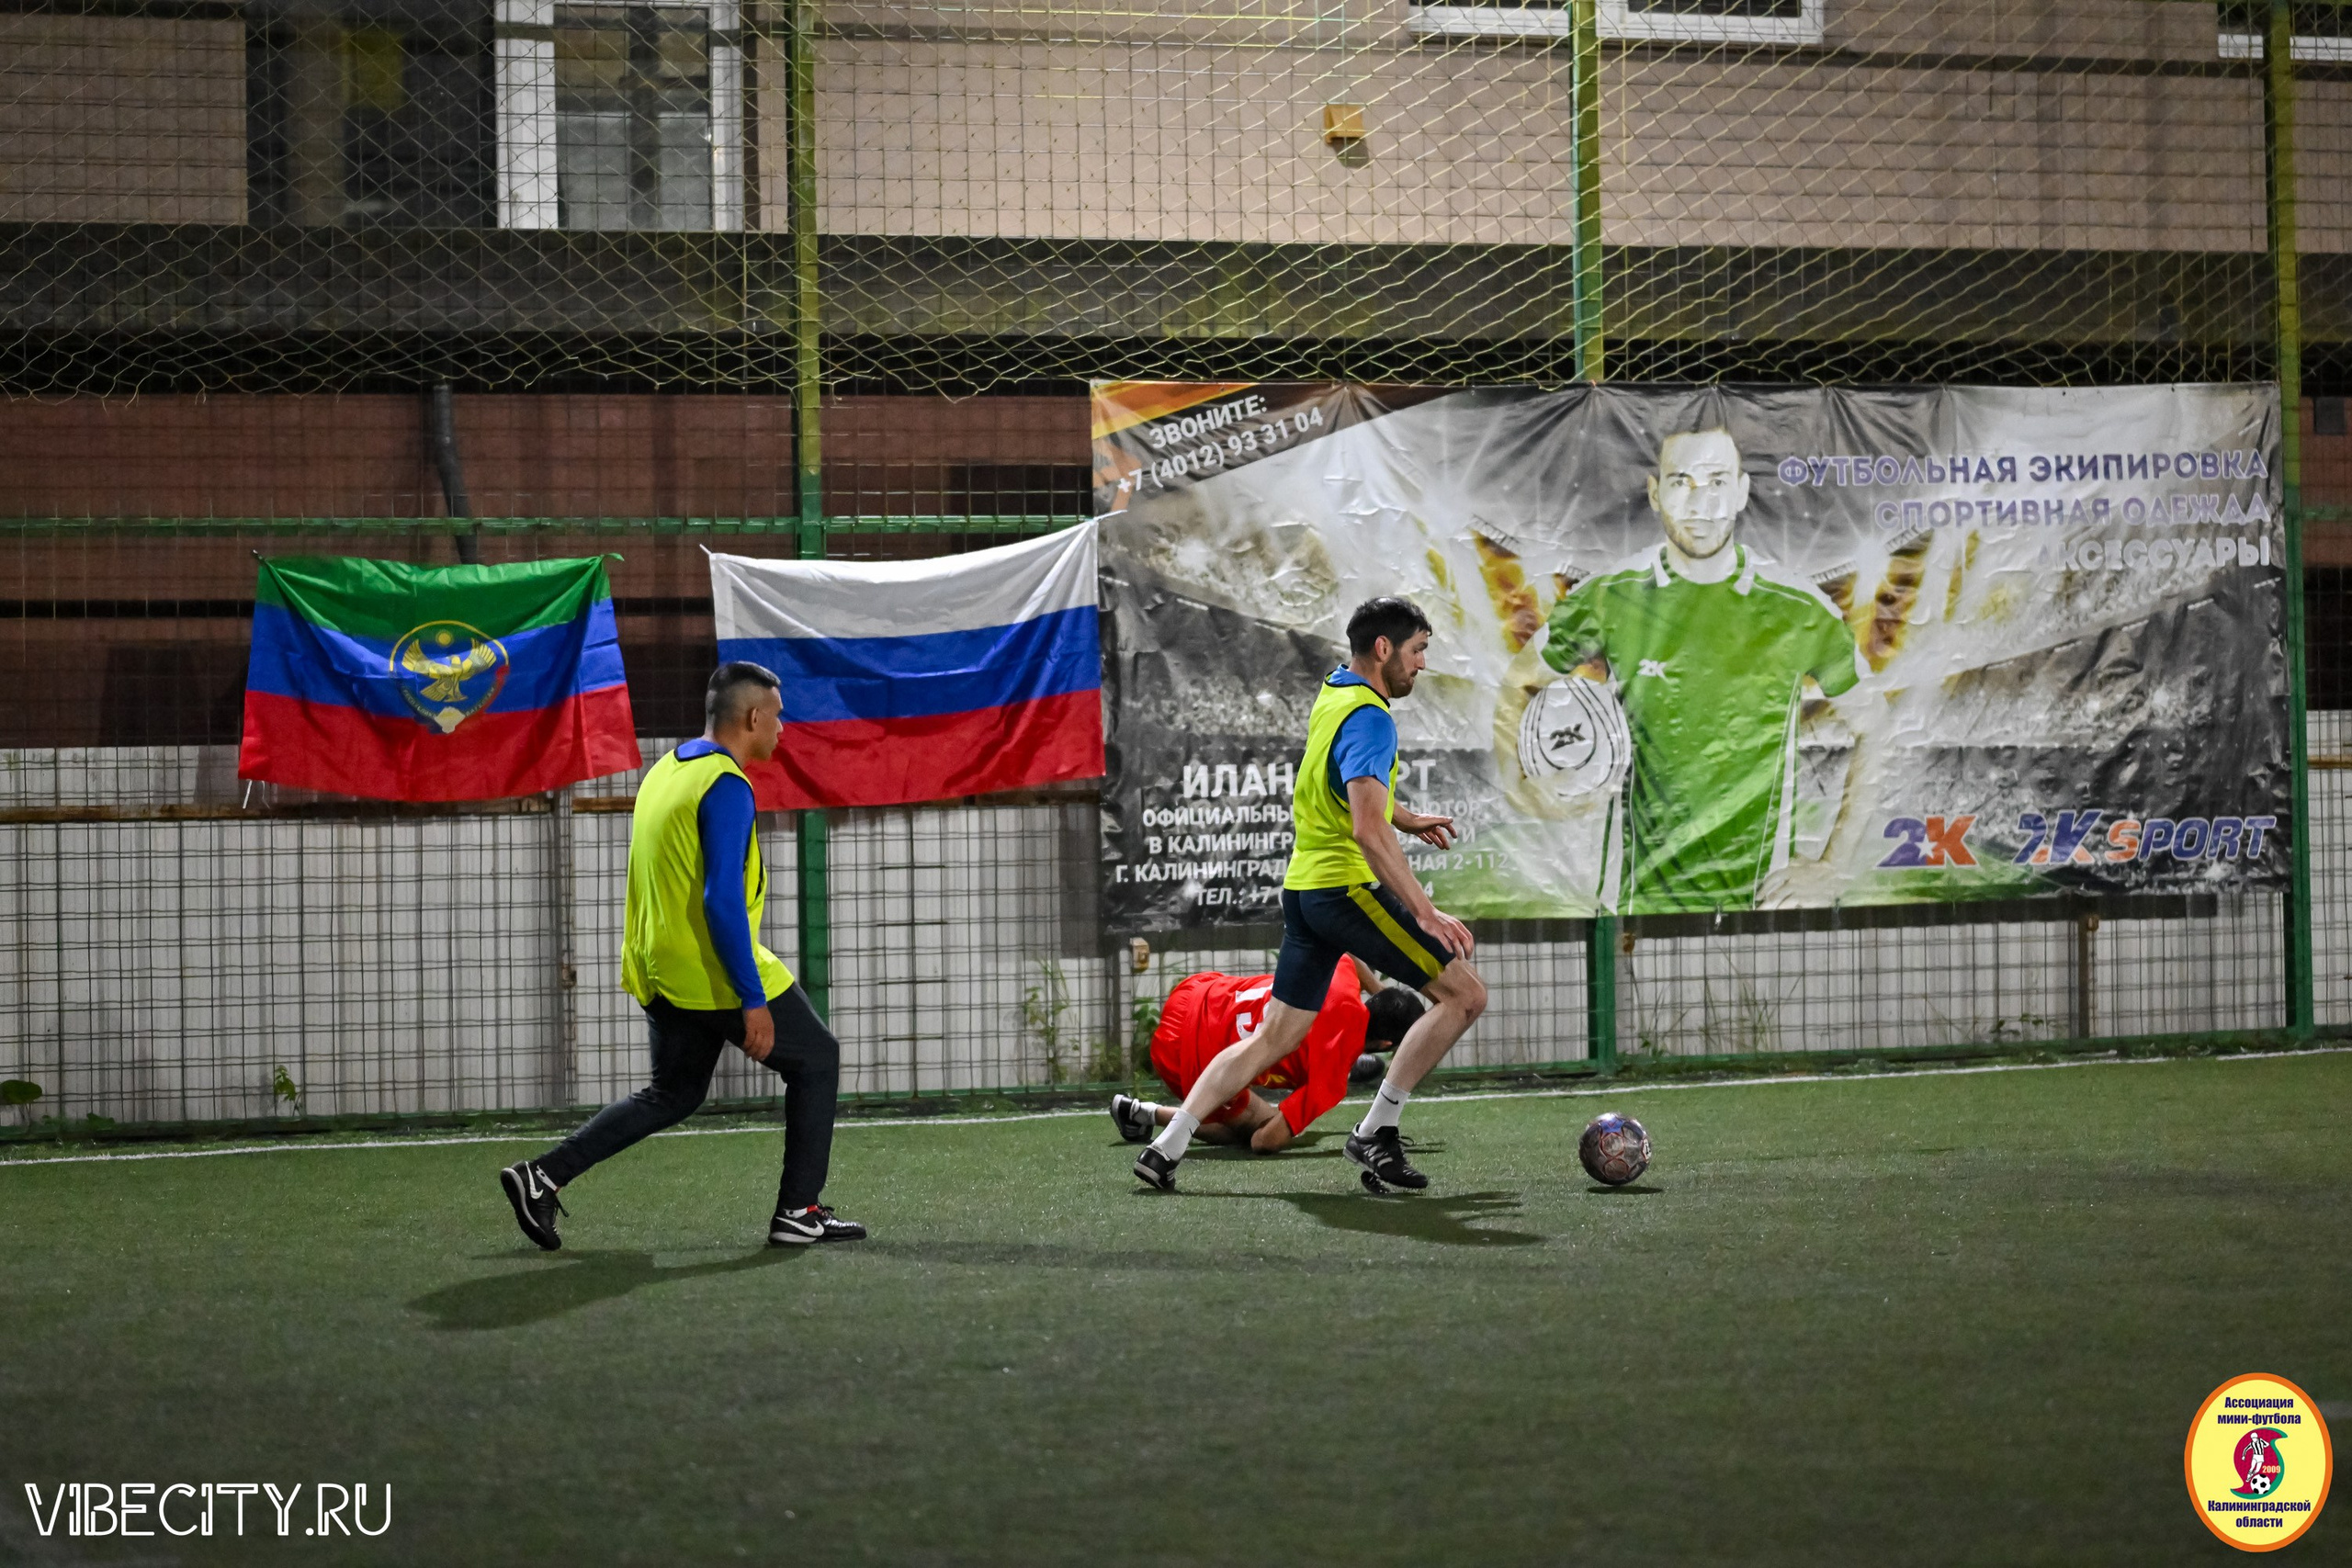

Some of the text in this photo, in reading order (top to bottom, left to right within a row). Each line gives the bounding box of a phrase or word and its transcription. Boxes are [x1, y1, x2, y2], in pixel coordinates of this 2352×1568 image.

[1149, 394, 1267, 449] ЗВОНИТЕ:
[1117, 407, 1324, 493] +7 (4012) 93 31 04
[1778, 450, 2268, 486] ФУТБОЛЬНАЯ ЭКИПИРОВКА
[1875, 492, 2270, 530] СПОРТИВНАЯ ОДЕЖДА
[1142, 805, 1295, 829] ОФИЦИАЛЬНЫ
[1149, 832, 1295, 854] В КАЛИНИНГР
[1876, 815, 1978, 869] 2K
[2105, 815, 2277, 863] SPORT
[1115, 864, 1129, 883] Г.
[1453, 852, 1509, 871] 2-112
[1250, 886, 1272, 903] +7
